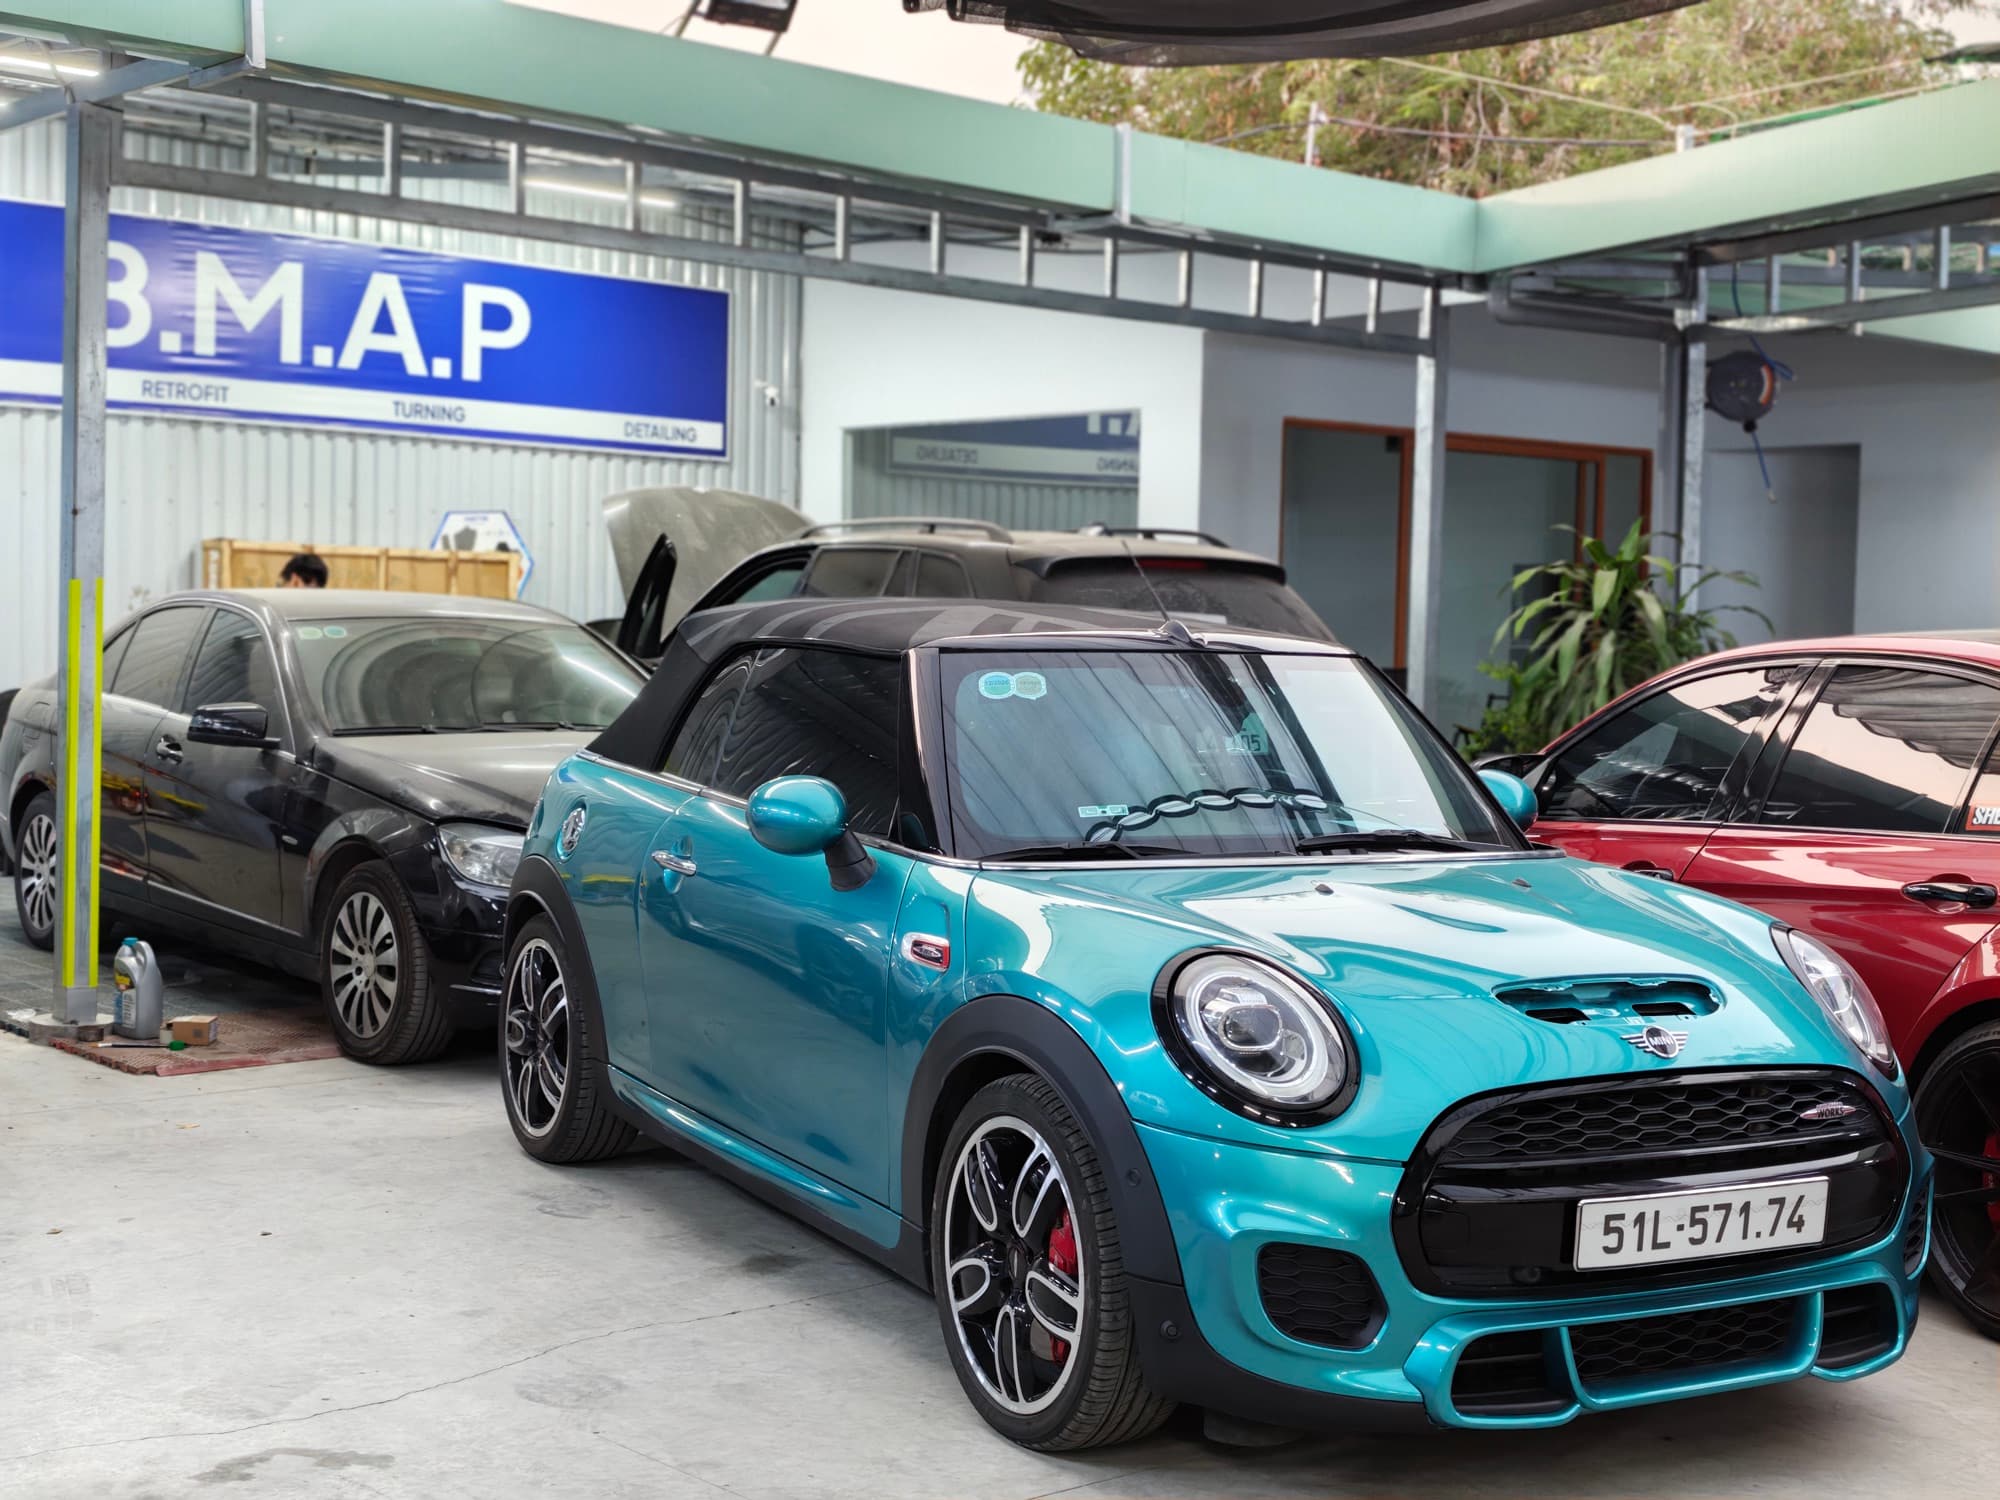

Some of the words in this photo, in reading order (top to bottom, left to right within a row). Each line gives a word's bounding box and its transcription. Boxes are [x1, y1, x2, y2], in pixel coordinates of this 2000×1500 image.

[141, 379, 229, 403] RETROFIT
[393, 400, 466, 422] TURNING
[624, 421, 697, 442] DETAILING
[1817, 1107, 1845, 1118] WORKS
